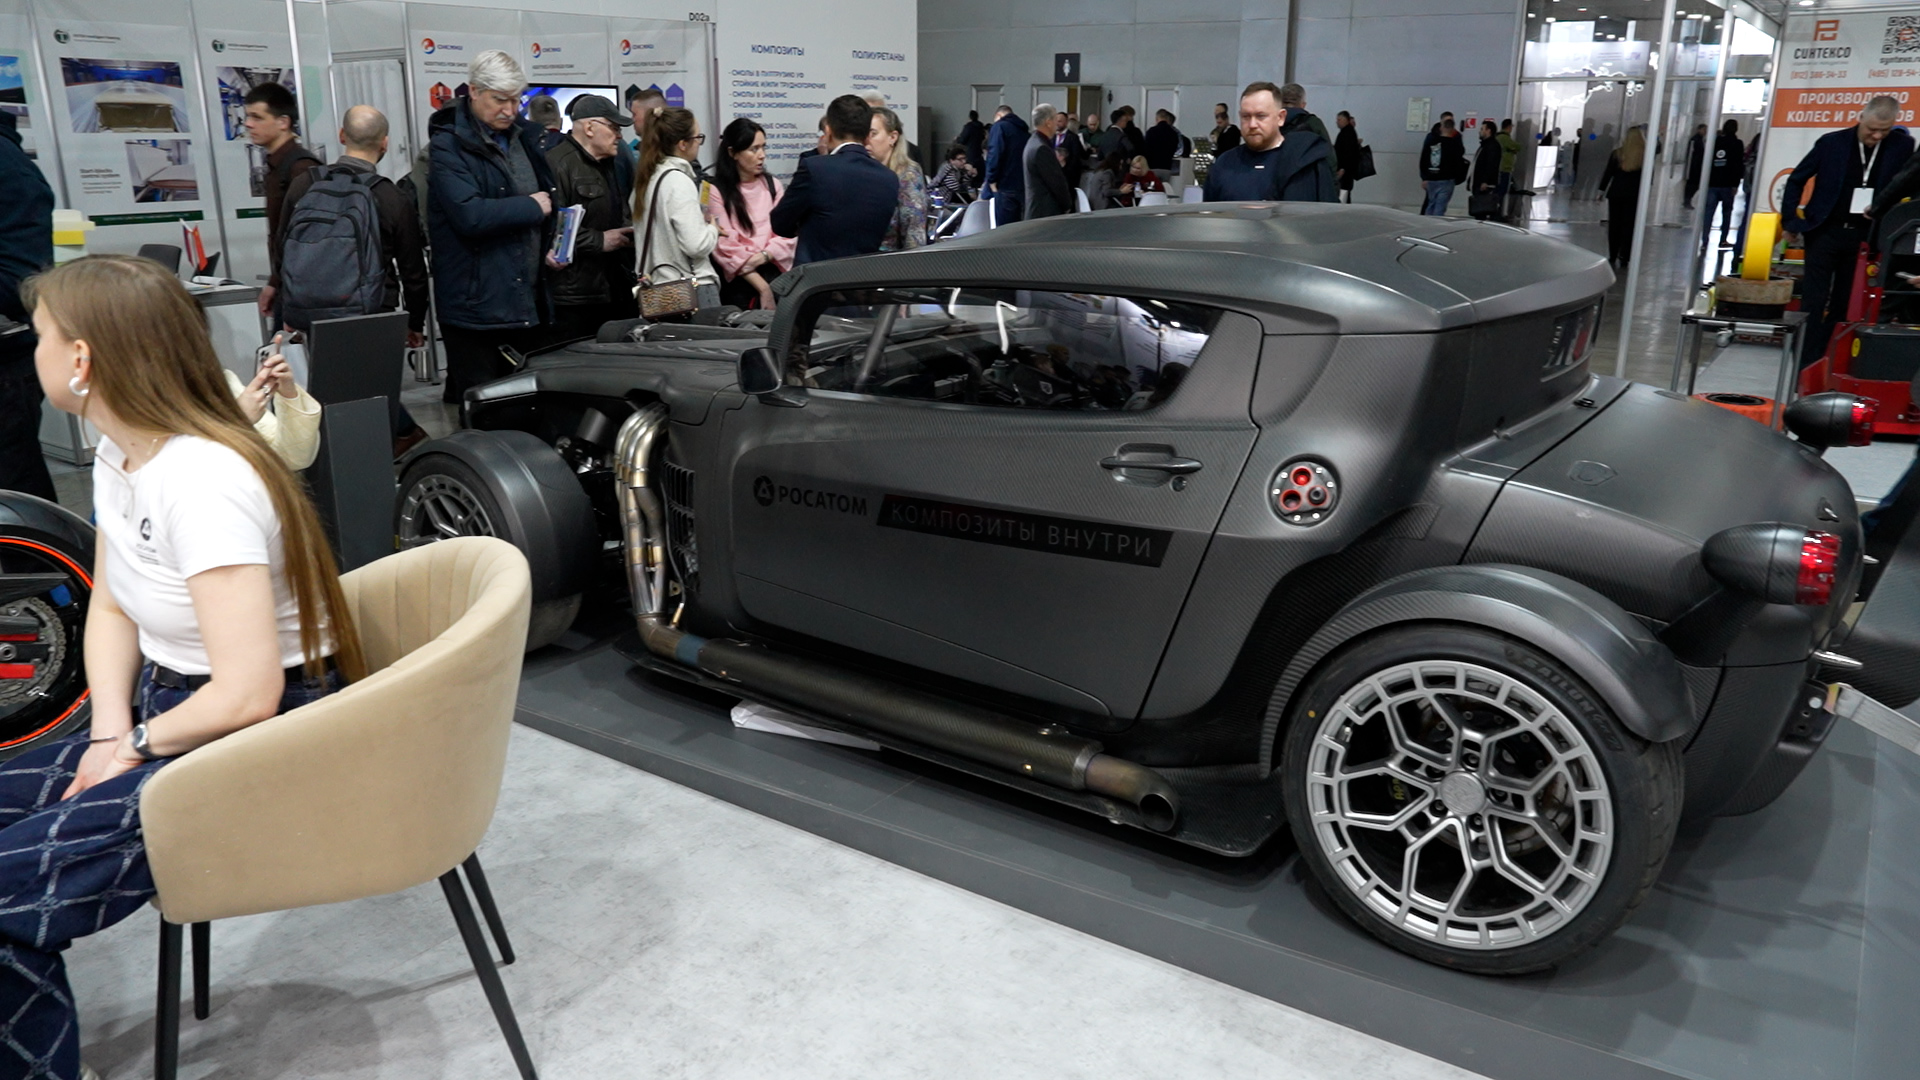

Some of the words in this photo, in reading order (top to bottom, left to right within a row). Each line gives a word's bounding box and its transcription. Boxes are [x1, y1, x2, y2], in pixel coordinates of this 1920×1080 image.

[751, 44, 805, 56] КОМПОЗИТЫ
[852, 50, 906, 62] ПОЛИУРЕТАНЫ
[1786, 110, 1831, 122] КОЛЕС
[1834, 111, 1844, 122] И
[1847, 109, 1915, 122] РООВ
[777, 485, 868, 517] РОСАТОМ
[890, 505, 1036, 542] КОМПОЗИТЫ
[1047, 526, 1152, 558] ВНУТРИ
[1523, 656, 1595, 716] SAILUN
